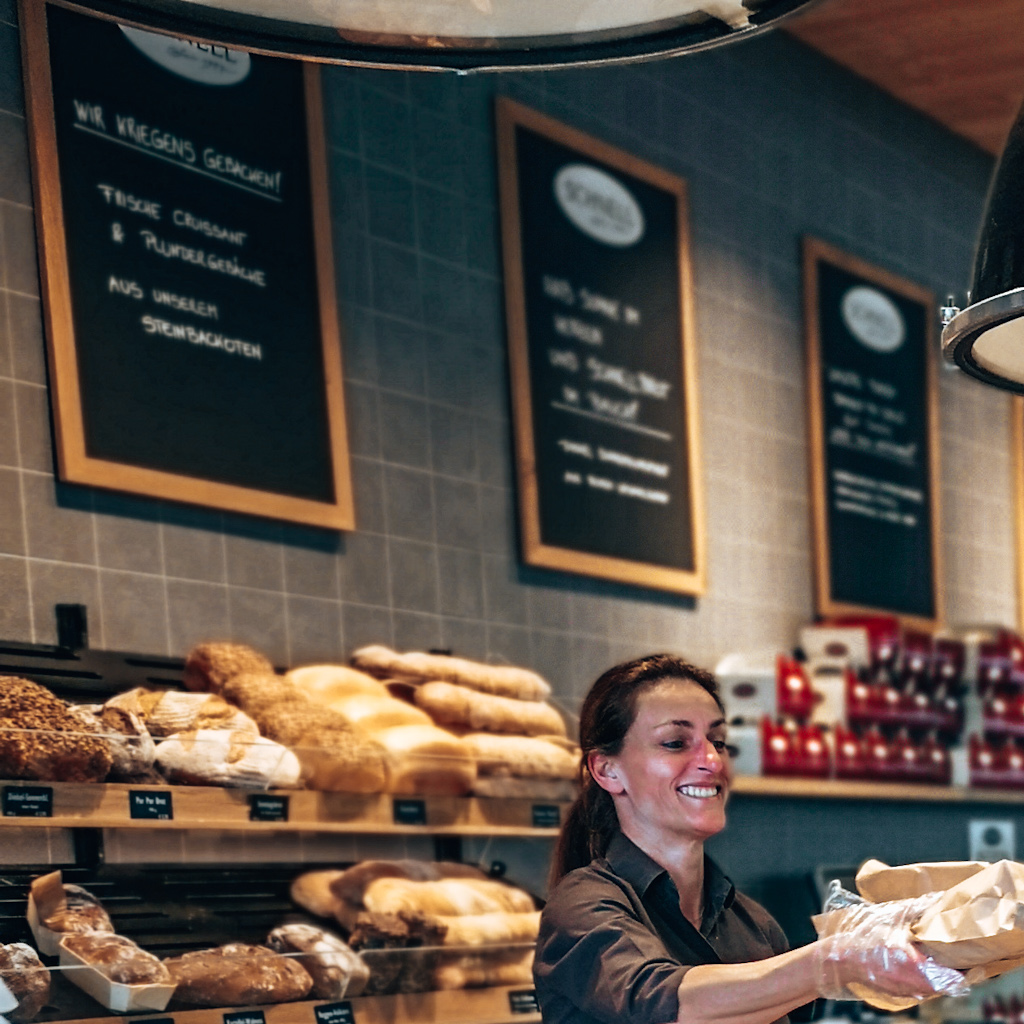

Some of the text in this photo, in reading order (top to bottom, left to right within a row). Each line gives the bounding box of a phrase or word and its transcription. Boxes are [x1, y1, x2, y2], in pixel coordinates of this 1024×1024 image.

[73, 99, 106, 131] WIR
[116, 114, 196, 162] KRIEGENS
[173, 209, 247, 246] CROISSANT
[108, 275, 218, 320] AUS UNSEREM
